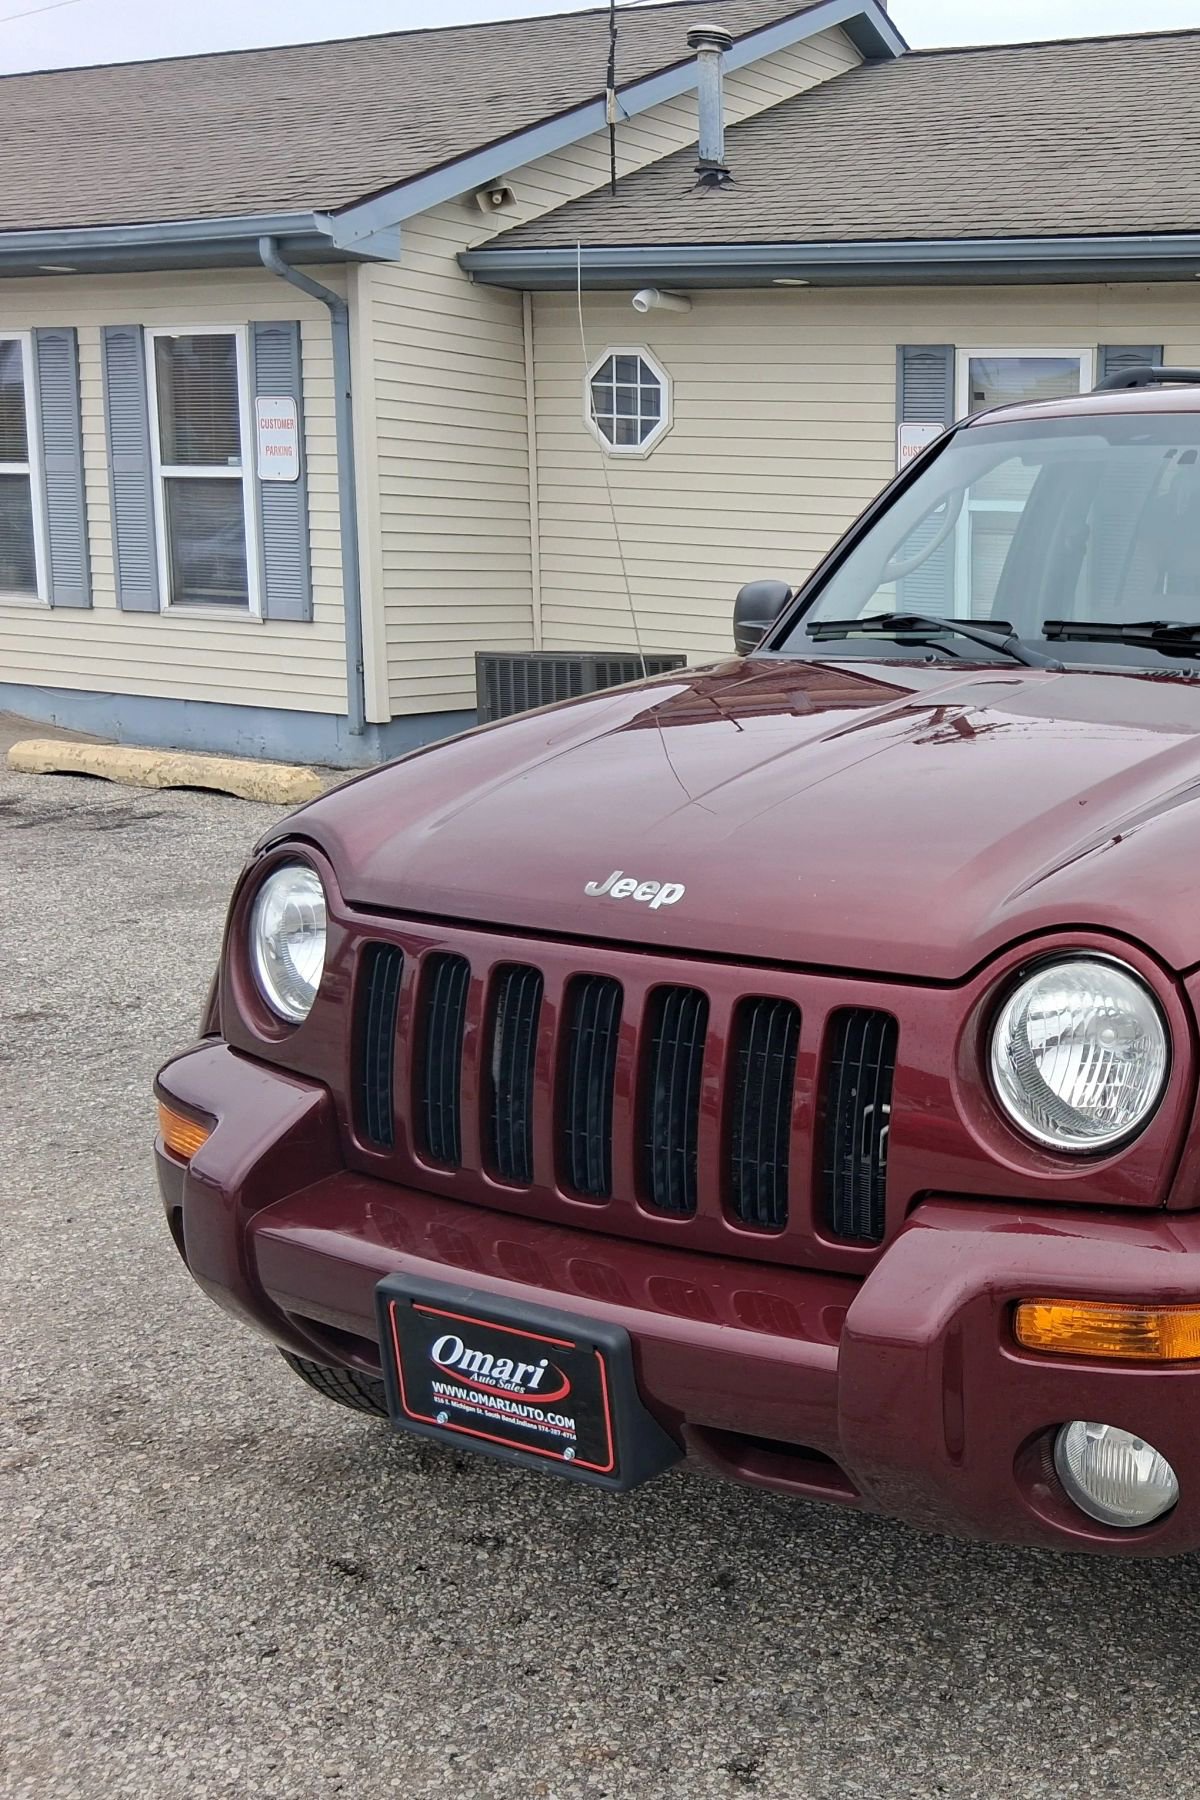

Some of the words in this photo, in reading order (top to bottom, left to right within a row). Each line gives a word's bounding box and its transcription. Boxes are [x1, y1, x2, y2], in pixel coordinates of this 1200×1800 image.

[260, 418, 294, 429] CUSTOMER
[265, 445, 293, 456] PARKING
[584, 870, 685, 909] Jeep
[431, 1334, 549, 1389] Omari
[469, 1372, 496, 1386] Auto
[497, 1379, 526, 1394] Sales
[431, 1381, 576, 1430] WWW.OMARIAUTO.COM
[450, 1400, 476, 1413] Michigan
